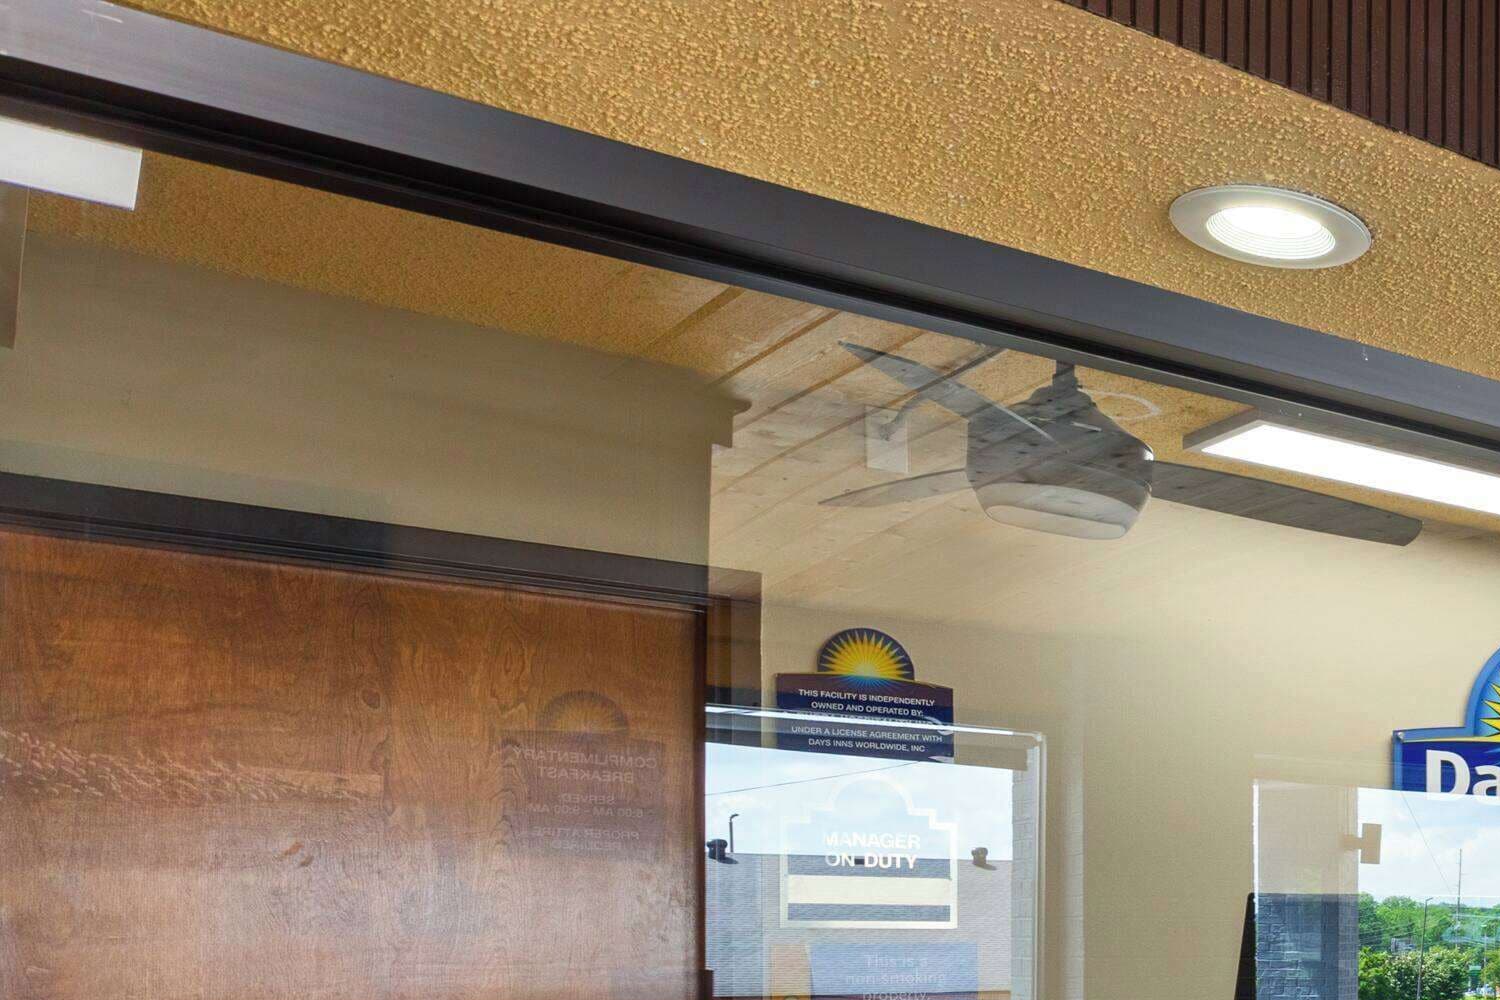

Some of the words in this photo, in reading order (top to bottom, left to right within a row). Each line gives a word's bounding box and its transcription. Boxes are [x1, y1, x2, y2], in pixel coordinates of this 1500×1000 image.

[798, 689, 819, 698] THIS
[819, 690, 858, 700] FACILITY
[868, 694, 936, 707] INDEPENDENTLY
[811, 701, 845, 711] OWNED
[845, 704, 865, 713] AND
[865, 705, 910, 716] OPERATED
[791, 726, 822, 735] UNDER
[823, 728, 831, 736] A
[831, 728, 868, 738] LICENSE
[868, 731, 921, 741] AGREEMENT
[921, 734, 943, 743] WITH
[808, 738, 832, 747] DAYS
[833, 739, 854, 748] INNS
[823, 831, 921, 849] MANAGER
[825, 852, 856, 867] ON
[864, 852, 918, 869] DUTY
